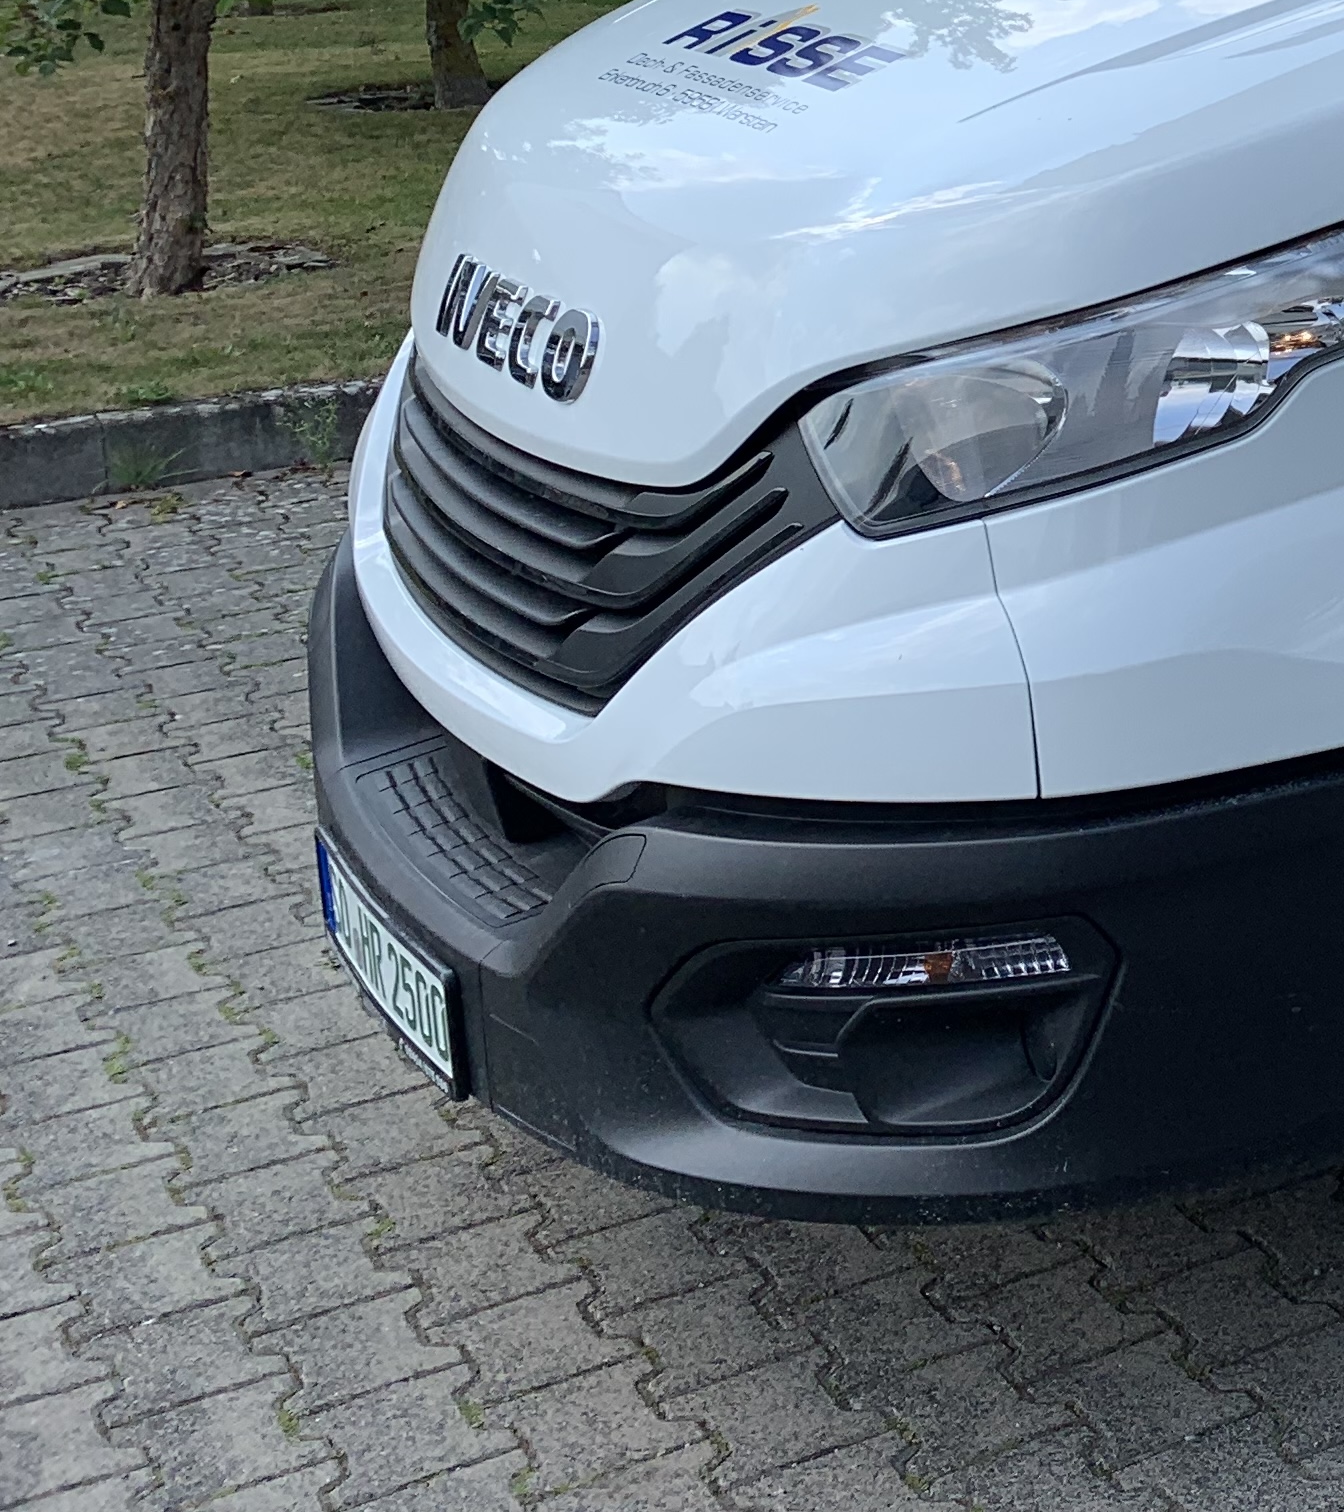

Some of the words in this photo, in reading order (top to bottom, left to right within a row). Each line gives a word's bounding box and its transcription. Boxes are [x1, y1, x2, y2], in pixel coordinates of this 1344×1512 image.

[682, 65, 809, 115] Fassadenservice
[435, 251, 603, 406] IVECO
[387, 941, 449, 1062] 2500
